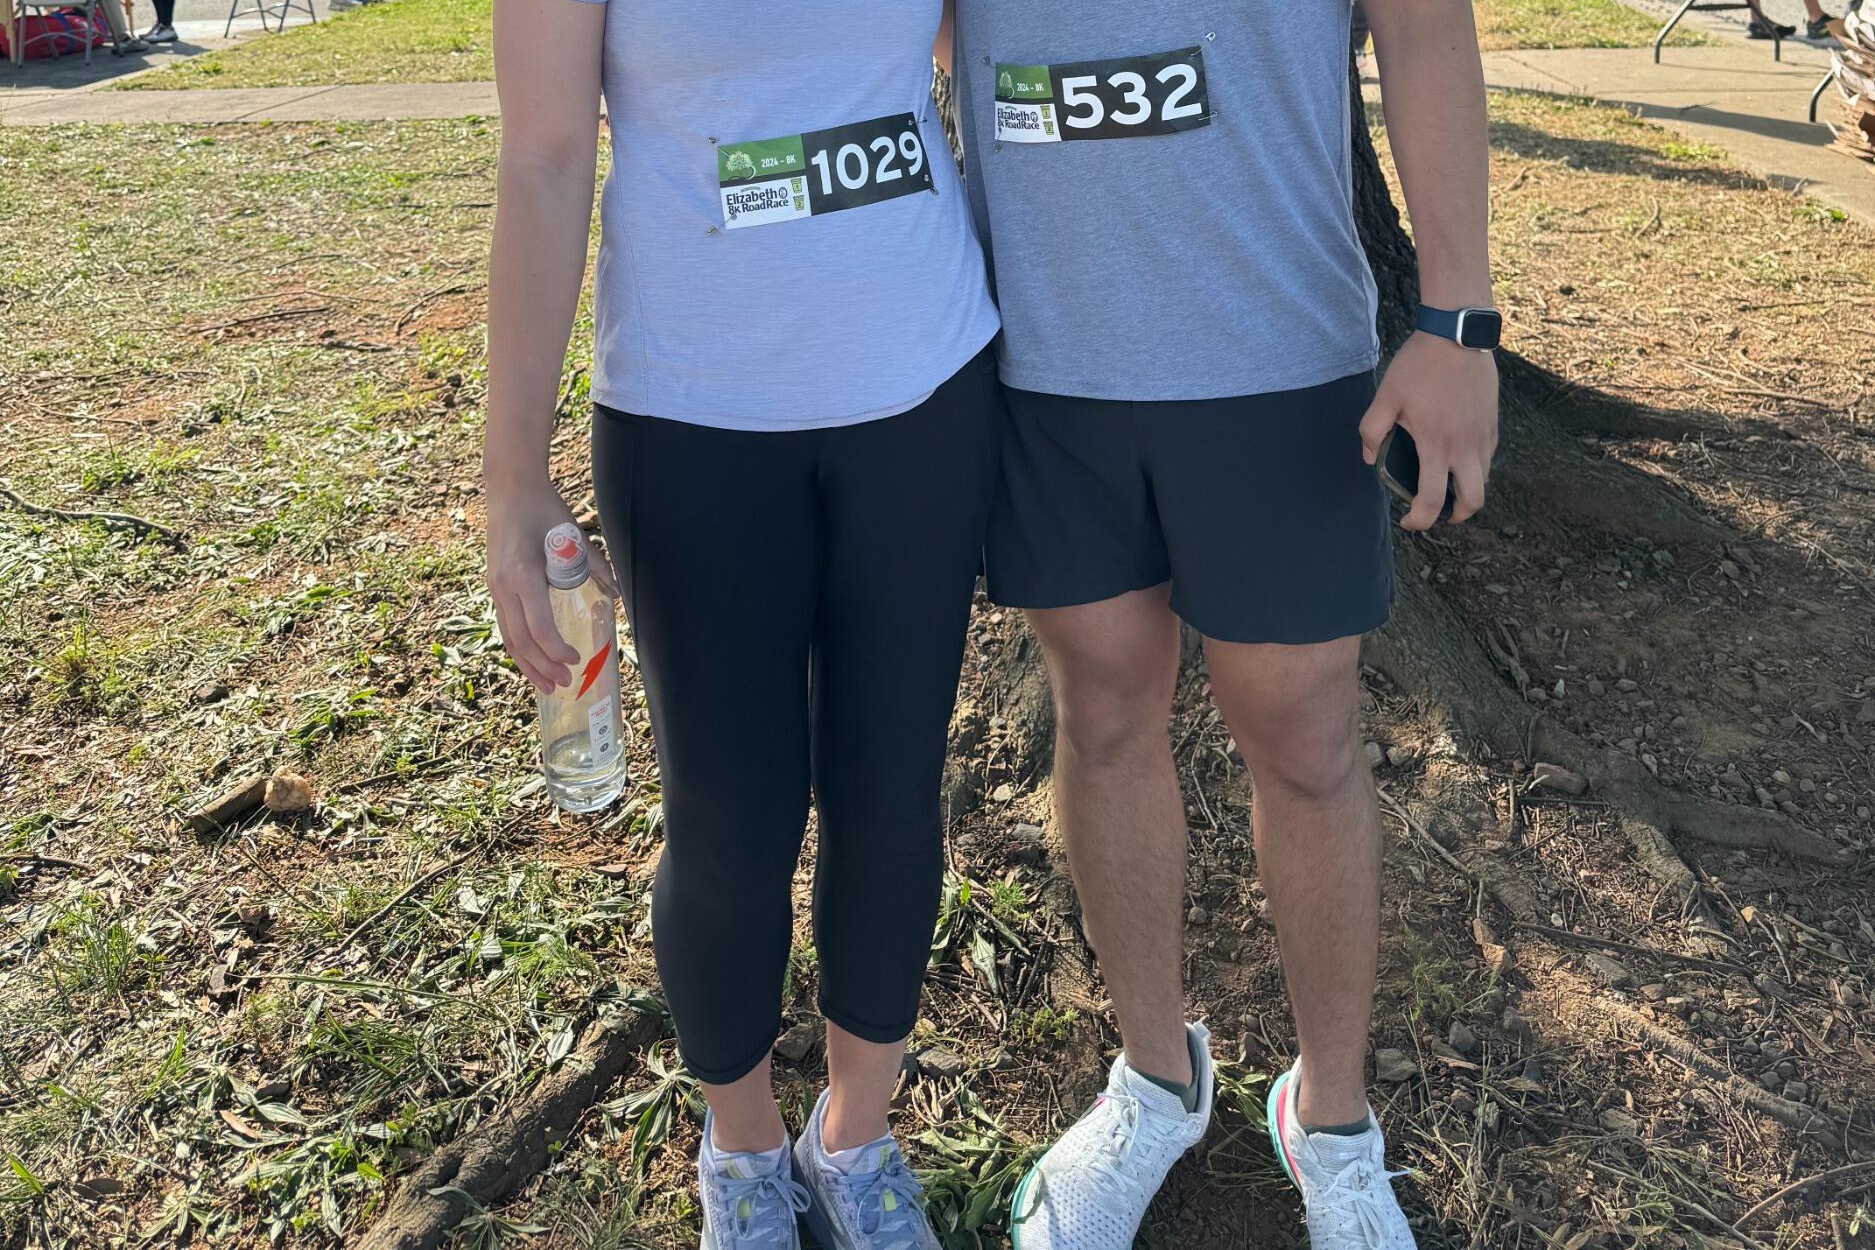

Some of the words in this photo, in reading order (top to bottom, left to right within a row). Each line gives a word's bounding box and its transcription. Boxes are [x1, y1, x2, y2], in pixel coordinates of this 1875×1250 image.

[1061, 63, 1203, 129] 532
[761, 157, 779, 168] 2024
[786, 154, 797, 165] 8K
[811, 130, 924, 196] 1029
[726, 188, 778, 206] Elizabeth
